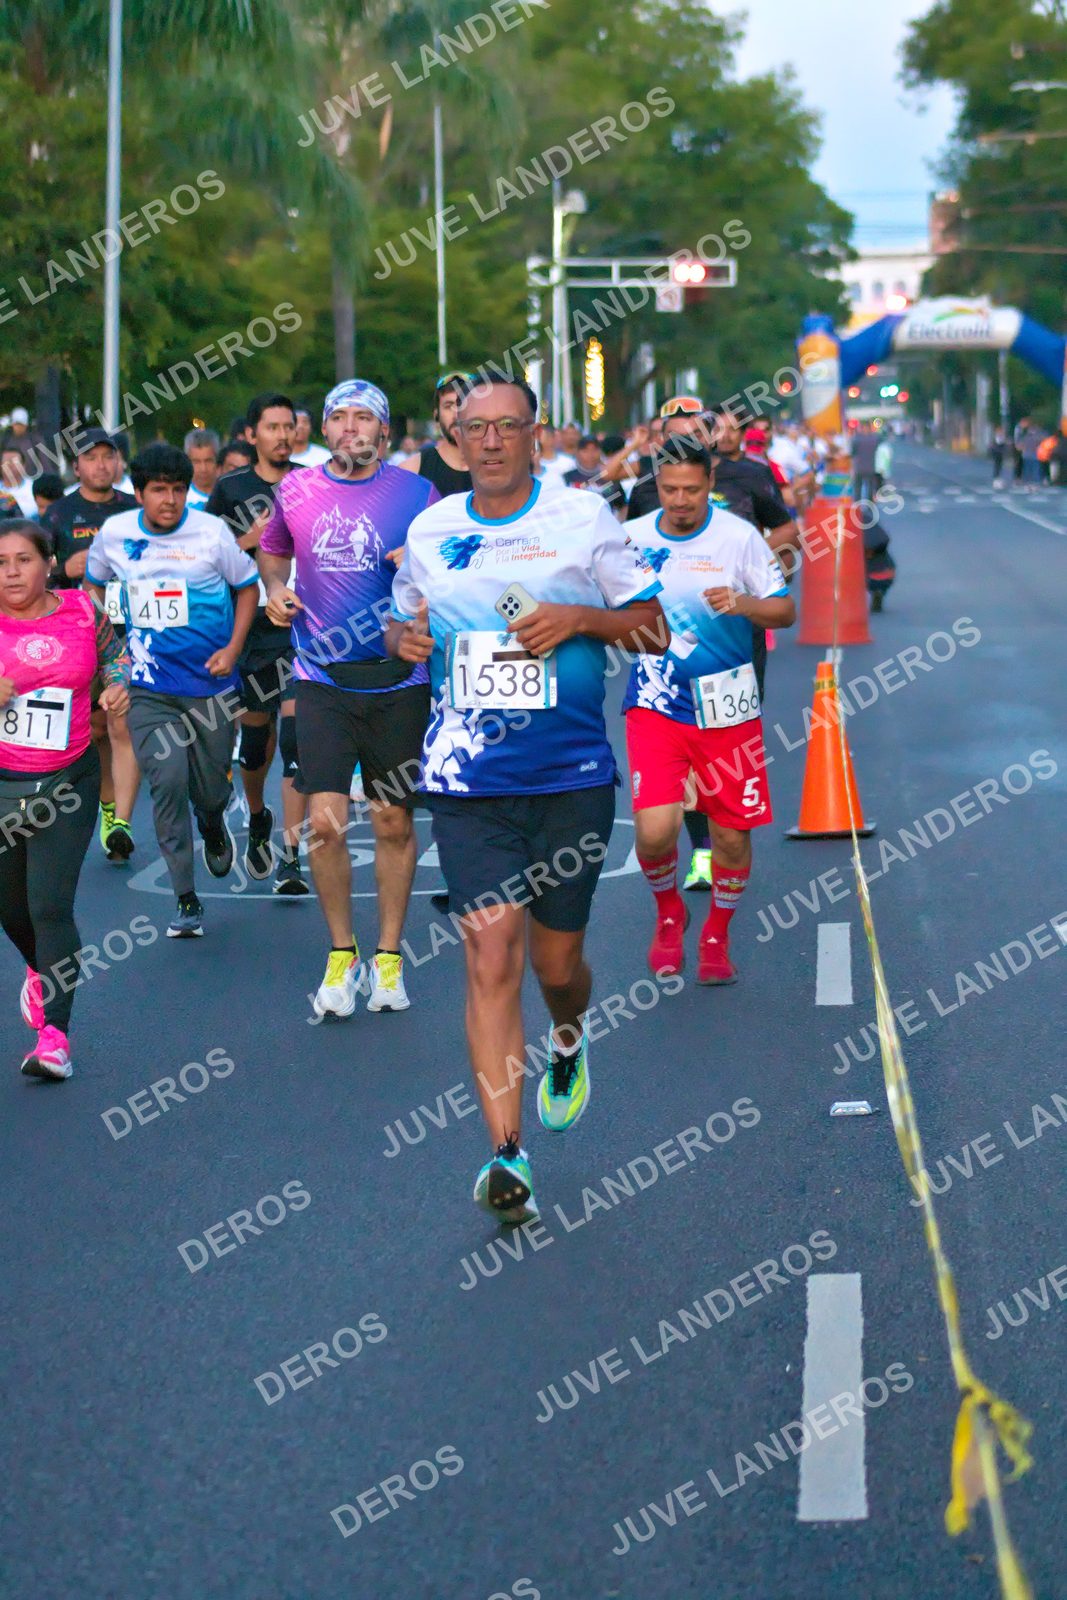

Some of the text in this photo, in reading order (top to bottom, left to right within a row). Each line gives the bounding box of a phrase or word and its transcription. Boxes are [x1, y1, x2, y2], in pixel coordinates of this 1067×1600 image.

[495, 537, 540, 548] Carrera
[521, 544, 540, 552] Vida
[511, 550, 557, 561] Integridad
[138, 599, 179, 620] 415
[458, 663, 541, 697] 1538
[707, 686, 760, 721] 1366
[3, 709, 52, 740] 811
[742, 777, 760, 807] 5
